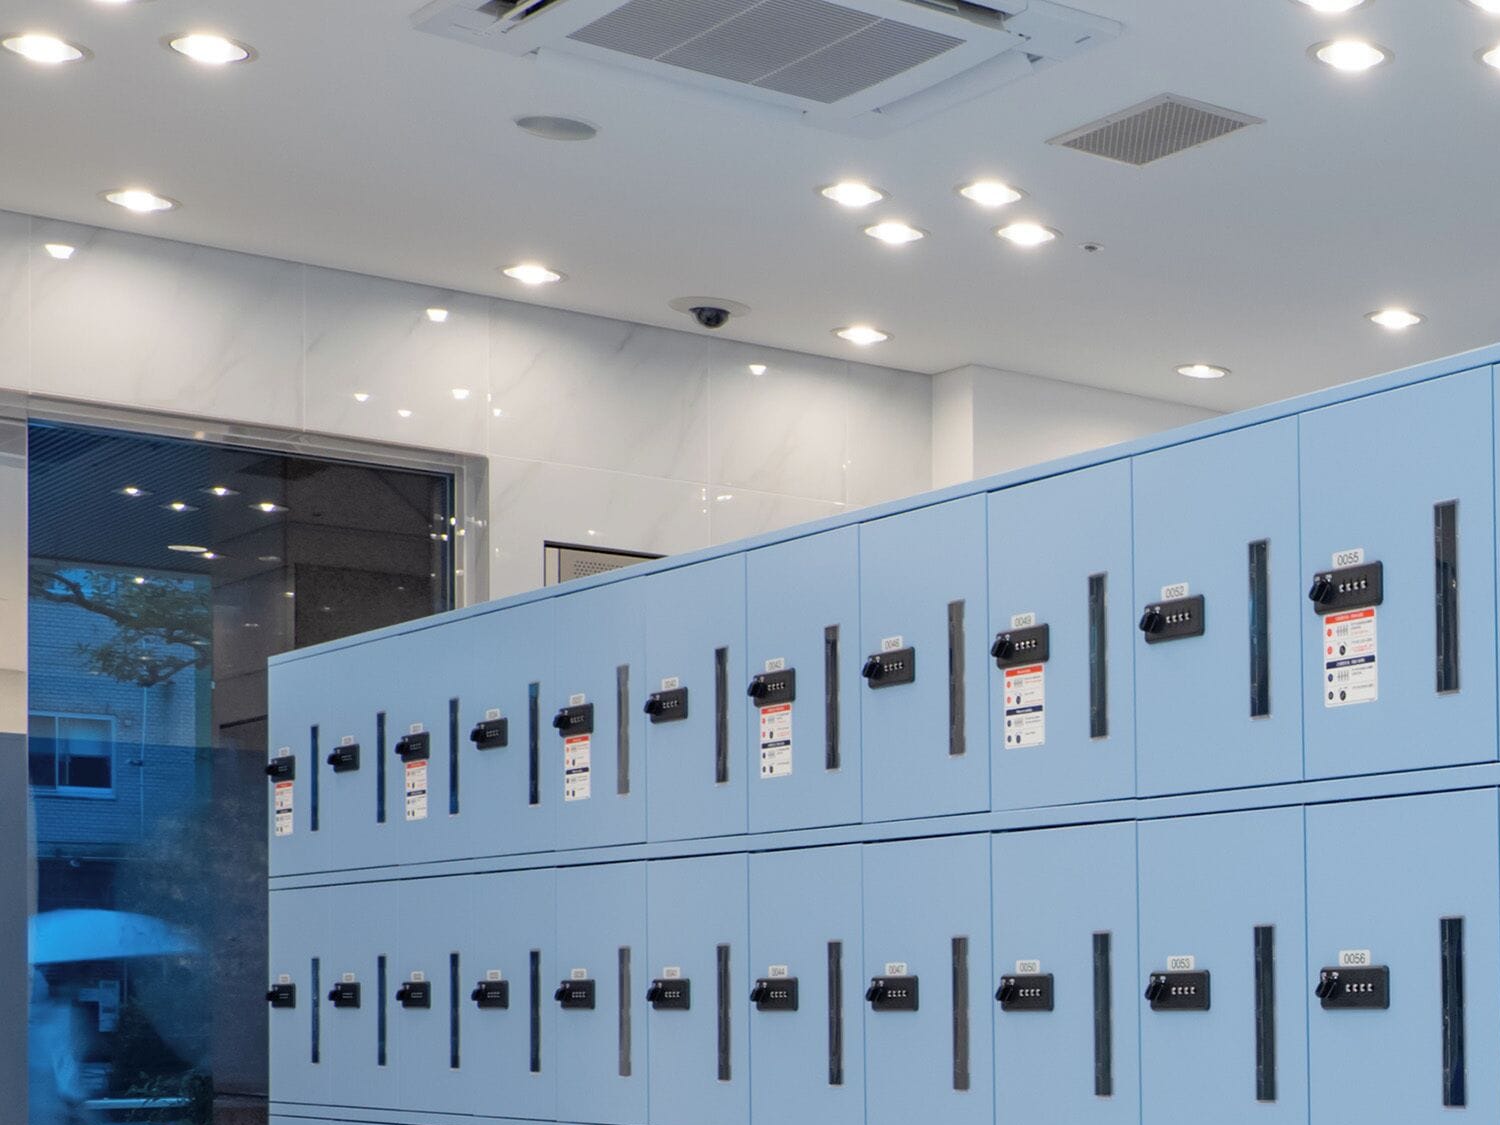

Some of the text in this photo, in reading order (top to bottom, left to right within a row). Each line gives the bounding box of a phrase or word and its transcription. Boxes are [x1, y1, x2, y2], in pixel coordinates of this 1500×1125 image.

[1337, 551, 1359, 566] 0055
[1165, 585, 1185, 599] 0052
[1171, 958, 1190, 969] 0053
[1344, 952, 1365, 964] 0056
